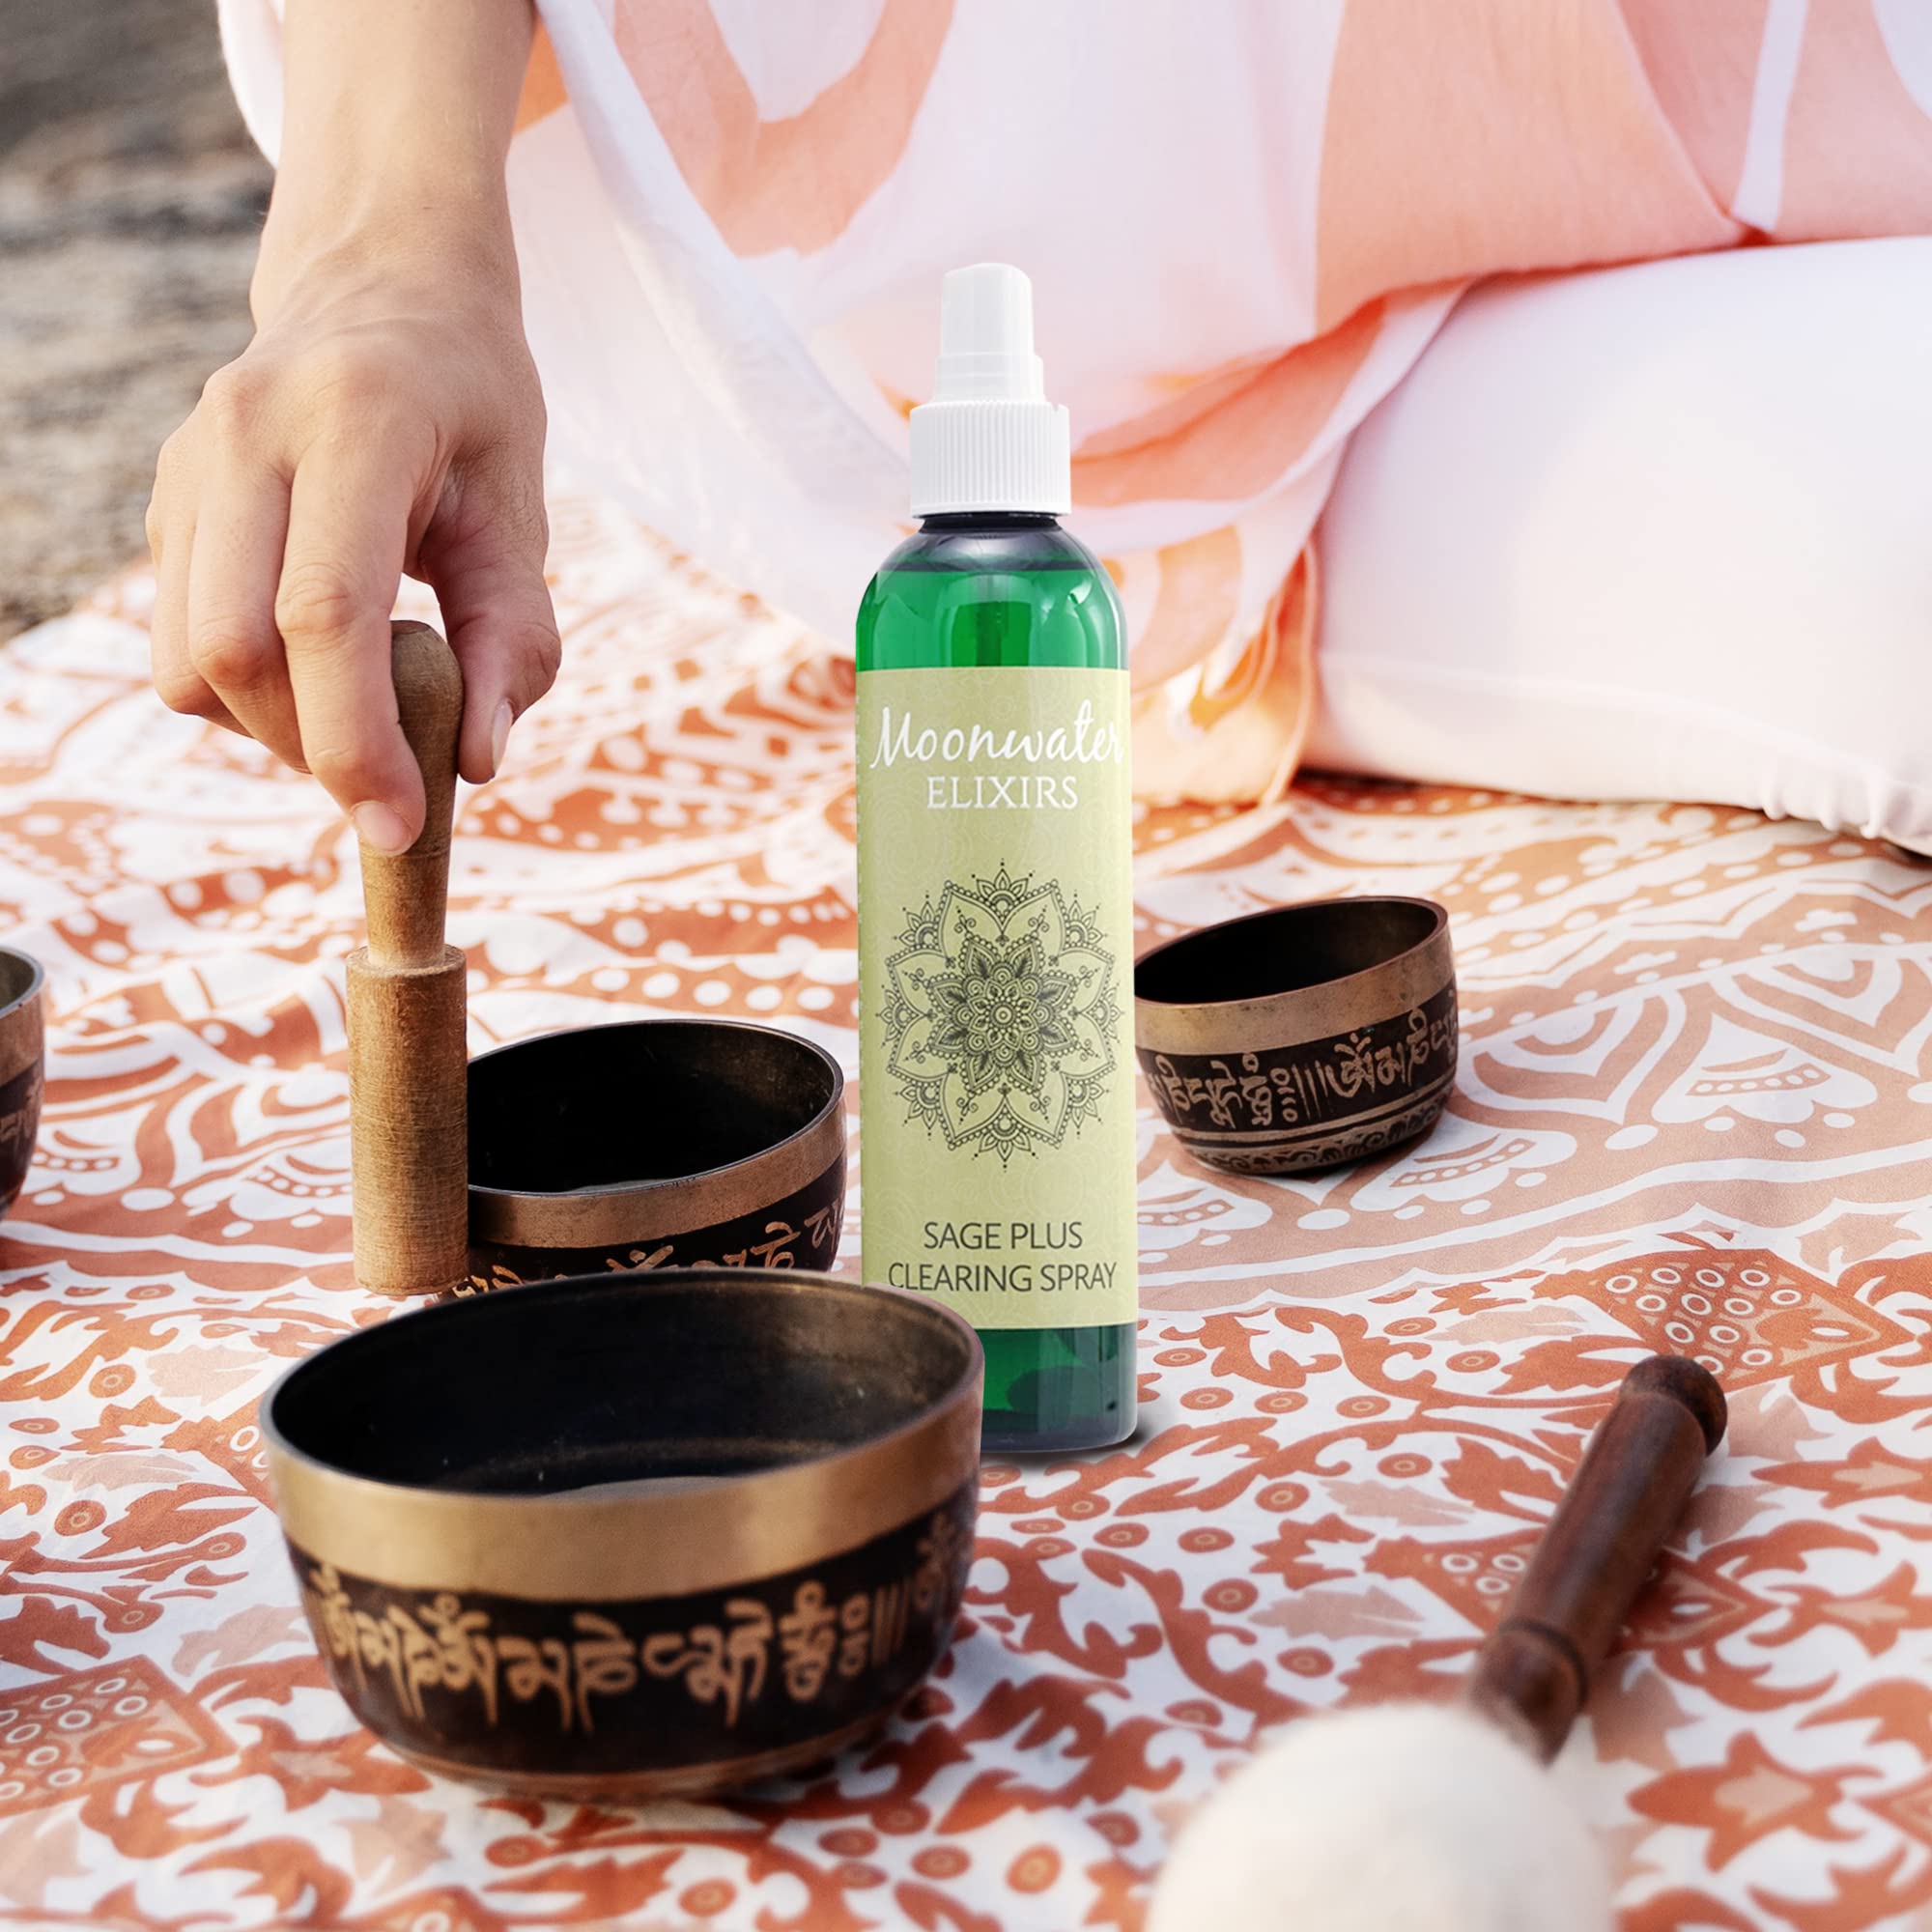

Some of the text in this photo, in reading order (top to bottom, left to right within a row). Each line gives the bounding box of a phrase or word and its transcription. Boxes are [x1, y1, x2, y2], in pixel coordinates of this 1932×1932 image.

[869, 698, 1124, 769] Moonwater
[926, 775, 1079, 810] ELIXIRS
[923, 1221, 1083, 1250] SAGE PLUS
[888, 1261, 1118, 1293] CLEARING SPRAY
